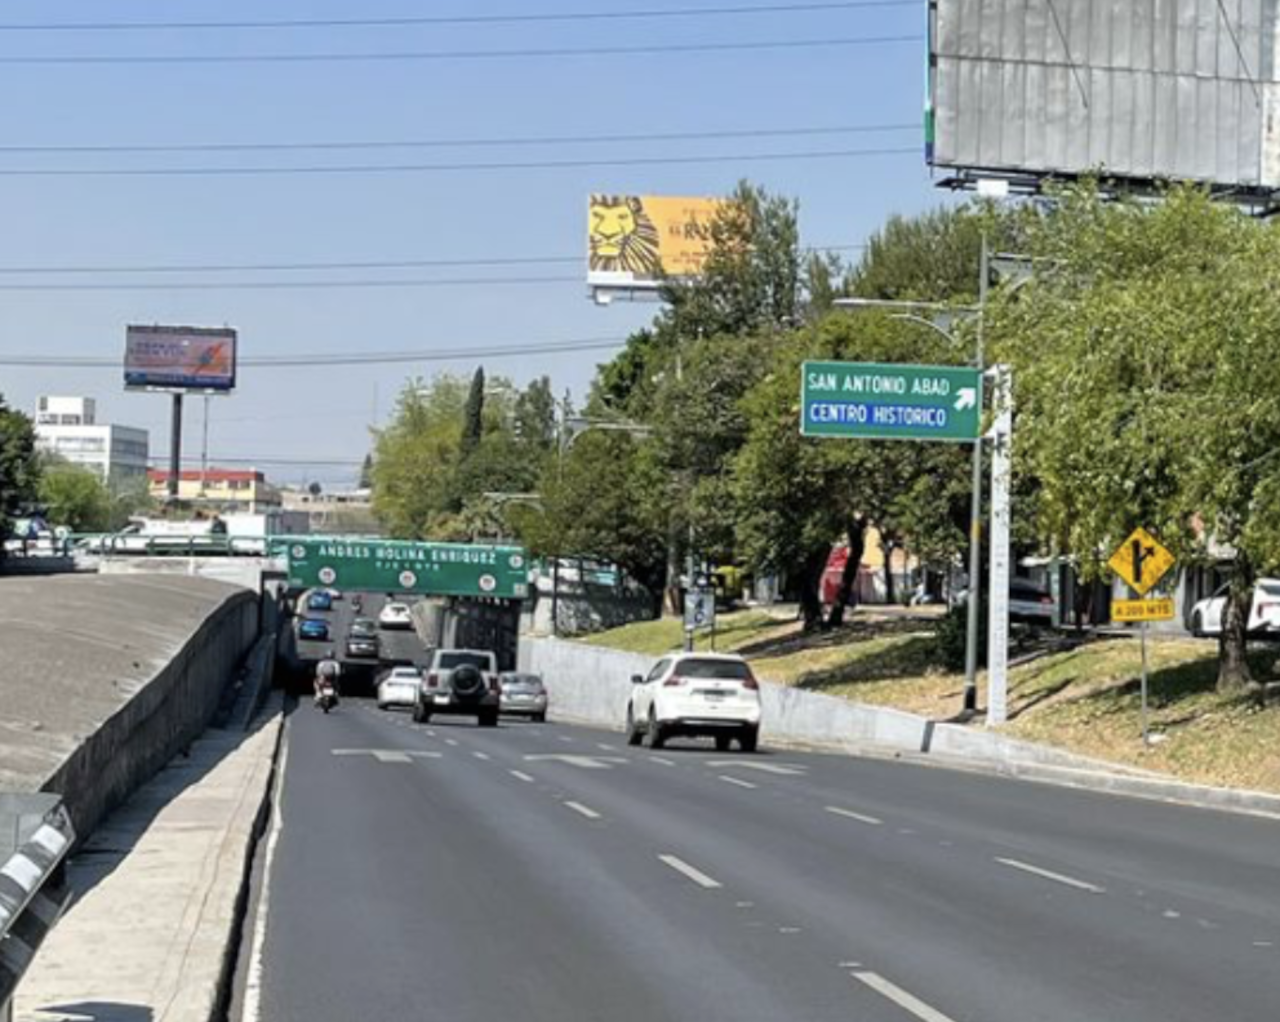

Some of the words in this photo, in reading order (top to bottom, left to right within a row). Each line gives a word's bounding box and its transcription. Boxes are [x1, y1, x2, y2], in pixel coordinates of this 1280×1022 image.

[808, 373, 836, 391] SAN
[842, 376, 905, 395] ANTONIO
[911, 379, 949, 396] ABAD
[810, 404, 867, 422] CENTRO
[873, 406, 946, 426] HISTORICO
